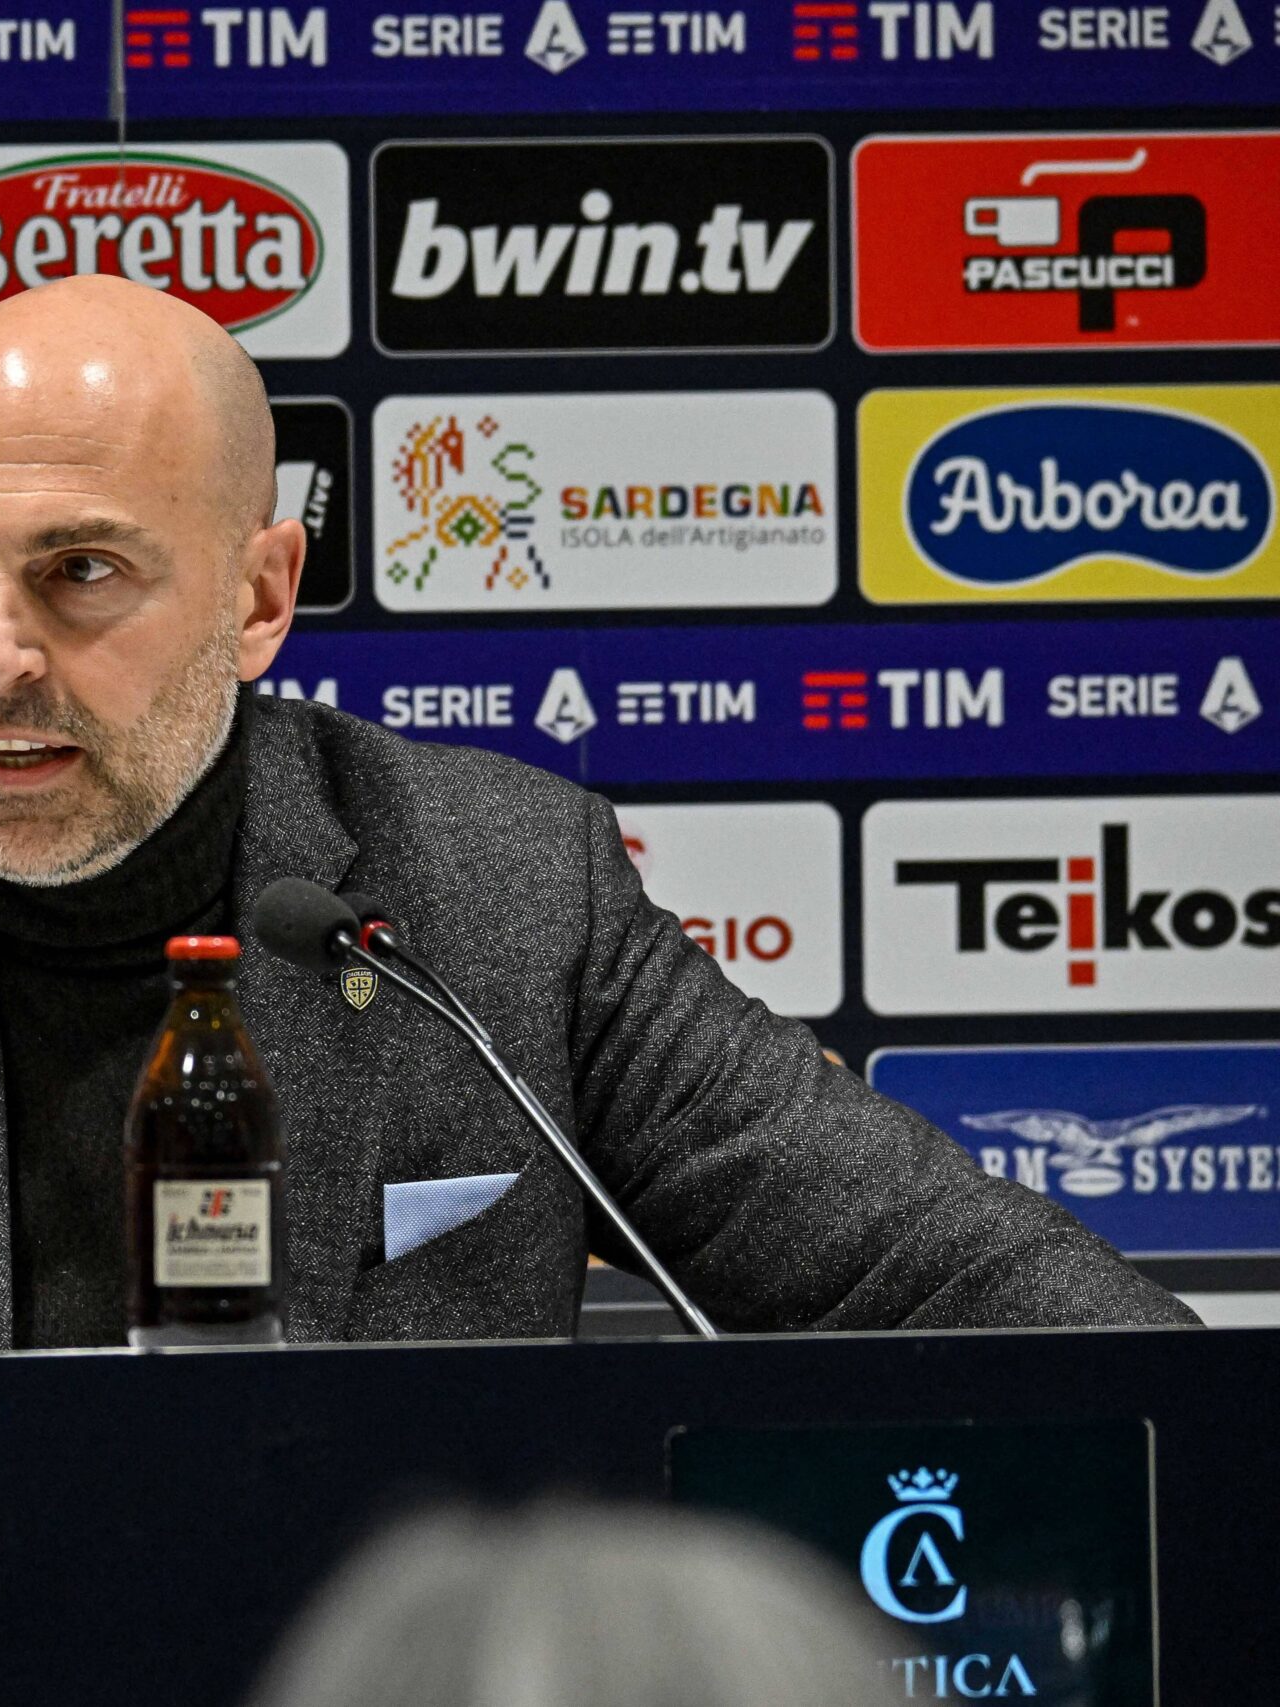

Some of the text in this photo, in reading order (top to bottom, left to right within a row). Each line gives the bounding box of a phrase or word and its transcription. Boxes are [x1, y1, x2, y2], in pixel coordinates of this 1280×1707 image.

[201, 8, 327, 67] TIM
[371, 15, 503, 57] SERIE
[659, 12, 745, 53] TIM
[869, 1, 993, 60] TIM
[1038, 8, 1169, 49] SERIE
[34, 173, 188, 211] Fratelli
[391, 190, 813, 298] bwin.tv
[965, 256, 1174, 290] PASCUCCI
[561, 484, 824, 520] SARDEGNA
[929, 457, 1247, 534] Arborea
[561, 524, 826, 552] ISOLA dell'Artigianato
[382, 685, 513, 729] SERIE
[668, 681, 755, 723] TIM
[877, 668, 1004, 729] TIM
[1047, 674, 1178, 717] SERIE
[894, 823, 1280, 986] Teikos
[1132, 1145, 1280, 1193] SYSTE
